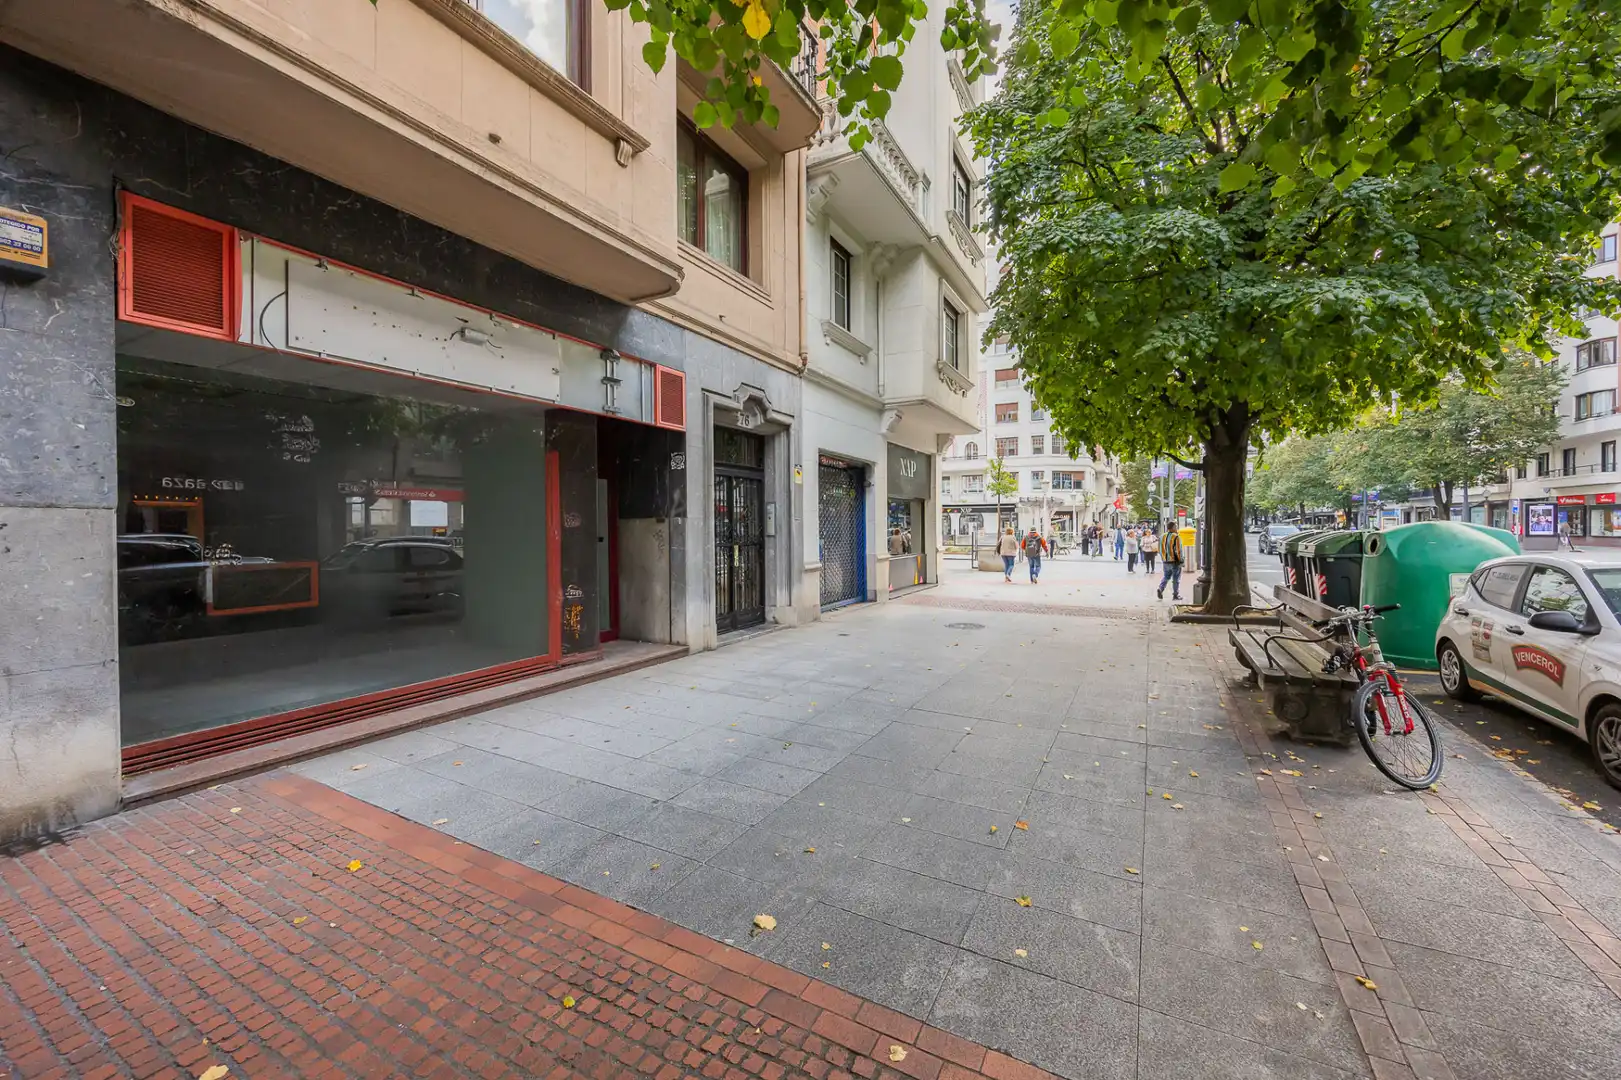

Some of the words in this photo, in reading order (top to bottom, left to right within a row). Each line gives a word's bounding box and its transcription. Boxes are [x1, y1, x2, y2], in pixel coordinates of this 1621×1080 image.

[27, 224, 39, 232] POR
[740, 413, 750, 426] 76
[1514, 651, 1560, 679] VENCEROL
